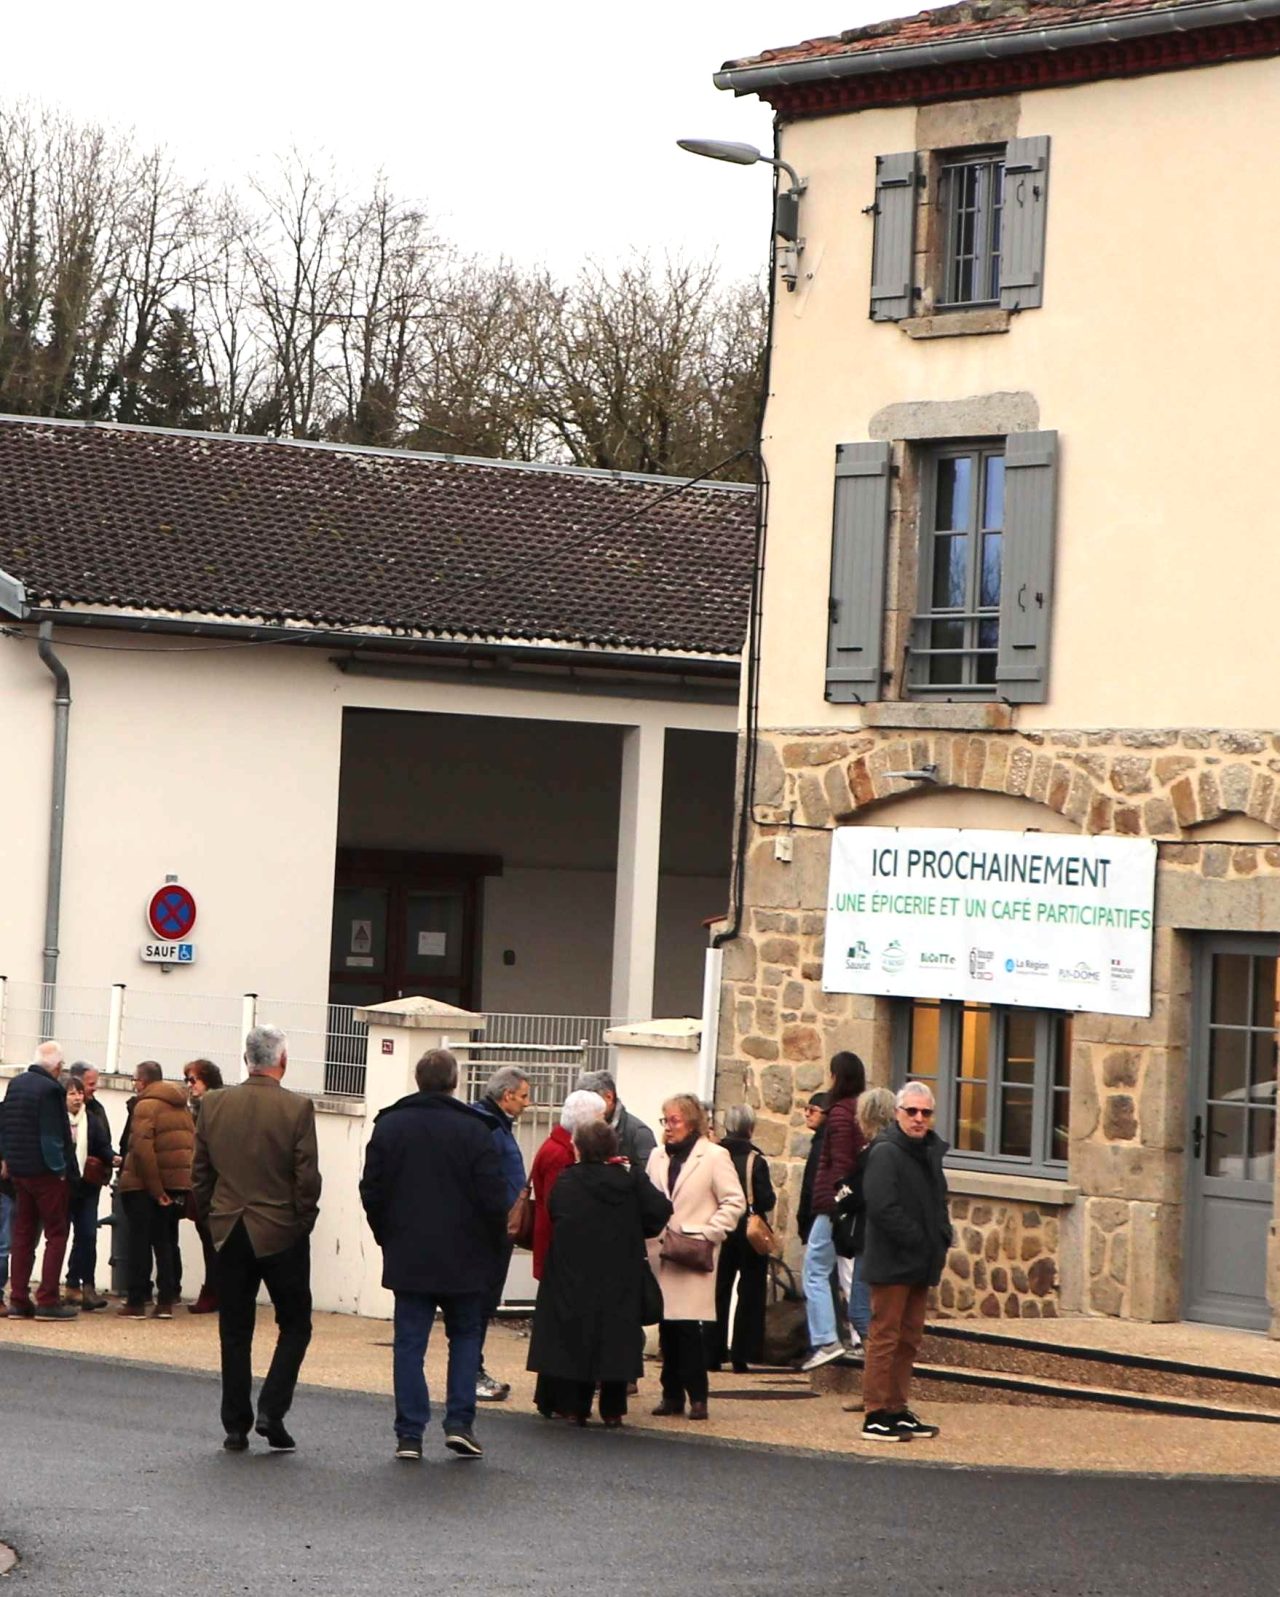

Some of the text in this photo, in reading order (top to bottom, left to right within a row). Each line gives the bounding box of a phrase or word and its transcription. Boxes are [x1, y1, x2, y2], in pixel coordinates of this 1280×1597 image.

[872, 848, 1111, 887] ICI PROCHAINEMENT
[836, 890, 1151, 930] UNE ÉPICERIE ET UN CAFÉ PARTICIPATIFS
[146, 945, 176, 957] SAUF
